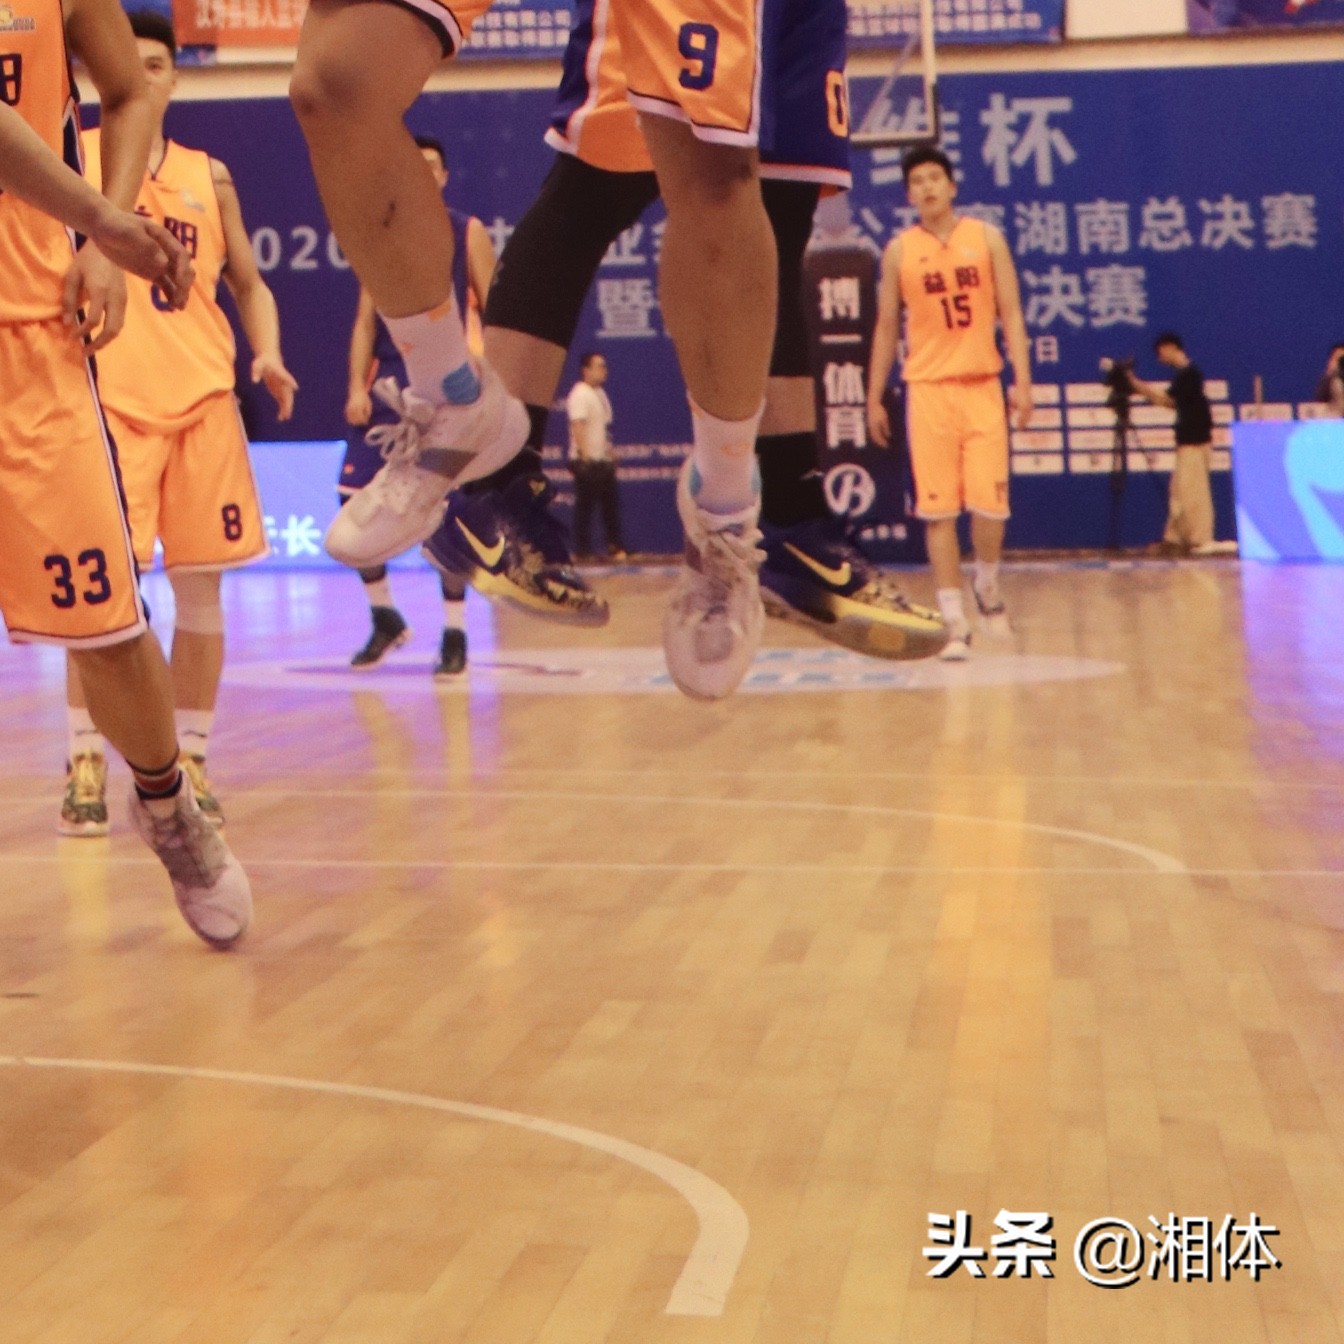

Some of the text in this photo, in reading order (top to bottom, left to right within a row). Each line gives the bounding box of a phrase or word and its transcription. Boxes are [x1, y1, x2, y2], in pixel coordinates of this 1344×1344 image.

[678, 22, 719, 91] 9
[921, 264, 981, 295] 益阳
[1022, 262, 1149, 329] 决赛
[940, 293, 974, 330] 15
[220, 503, 243, 542] 8
[43, 547, 112, 609] 33
